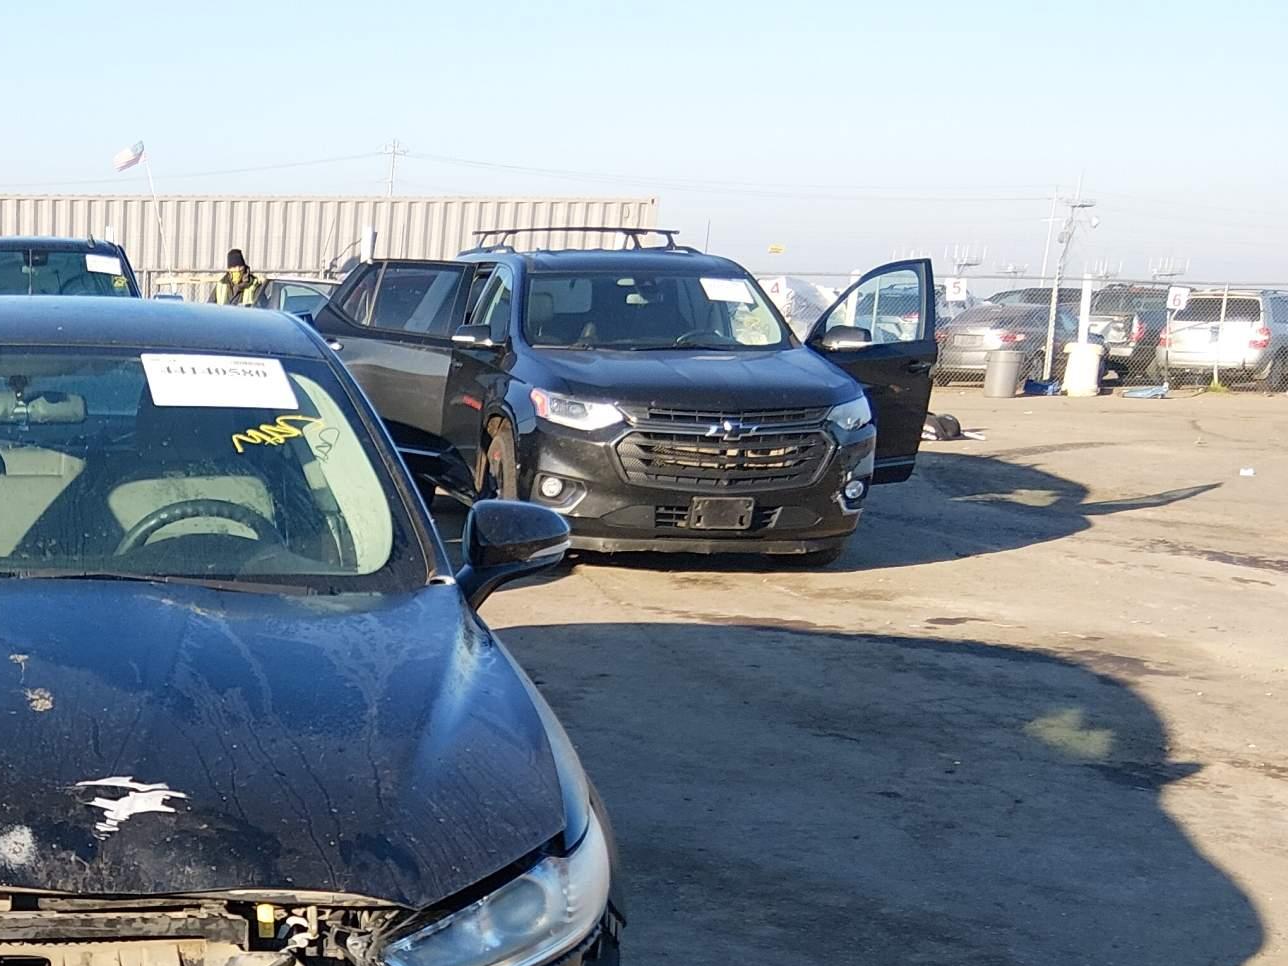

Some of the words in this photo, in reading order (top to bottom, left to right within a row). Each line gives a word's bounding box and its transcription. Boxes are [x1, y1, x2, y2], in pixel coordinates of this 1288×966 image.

[770, 281, 780, 294] 4
[952, 280, 962, 295] 5
[1172, 294, 1182, 307] 6
